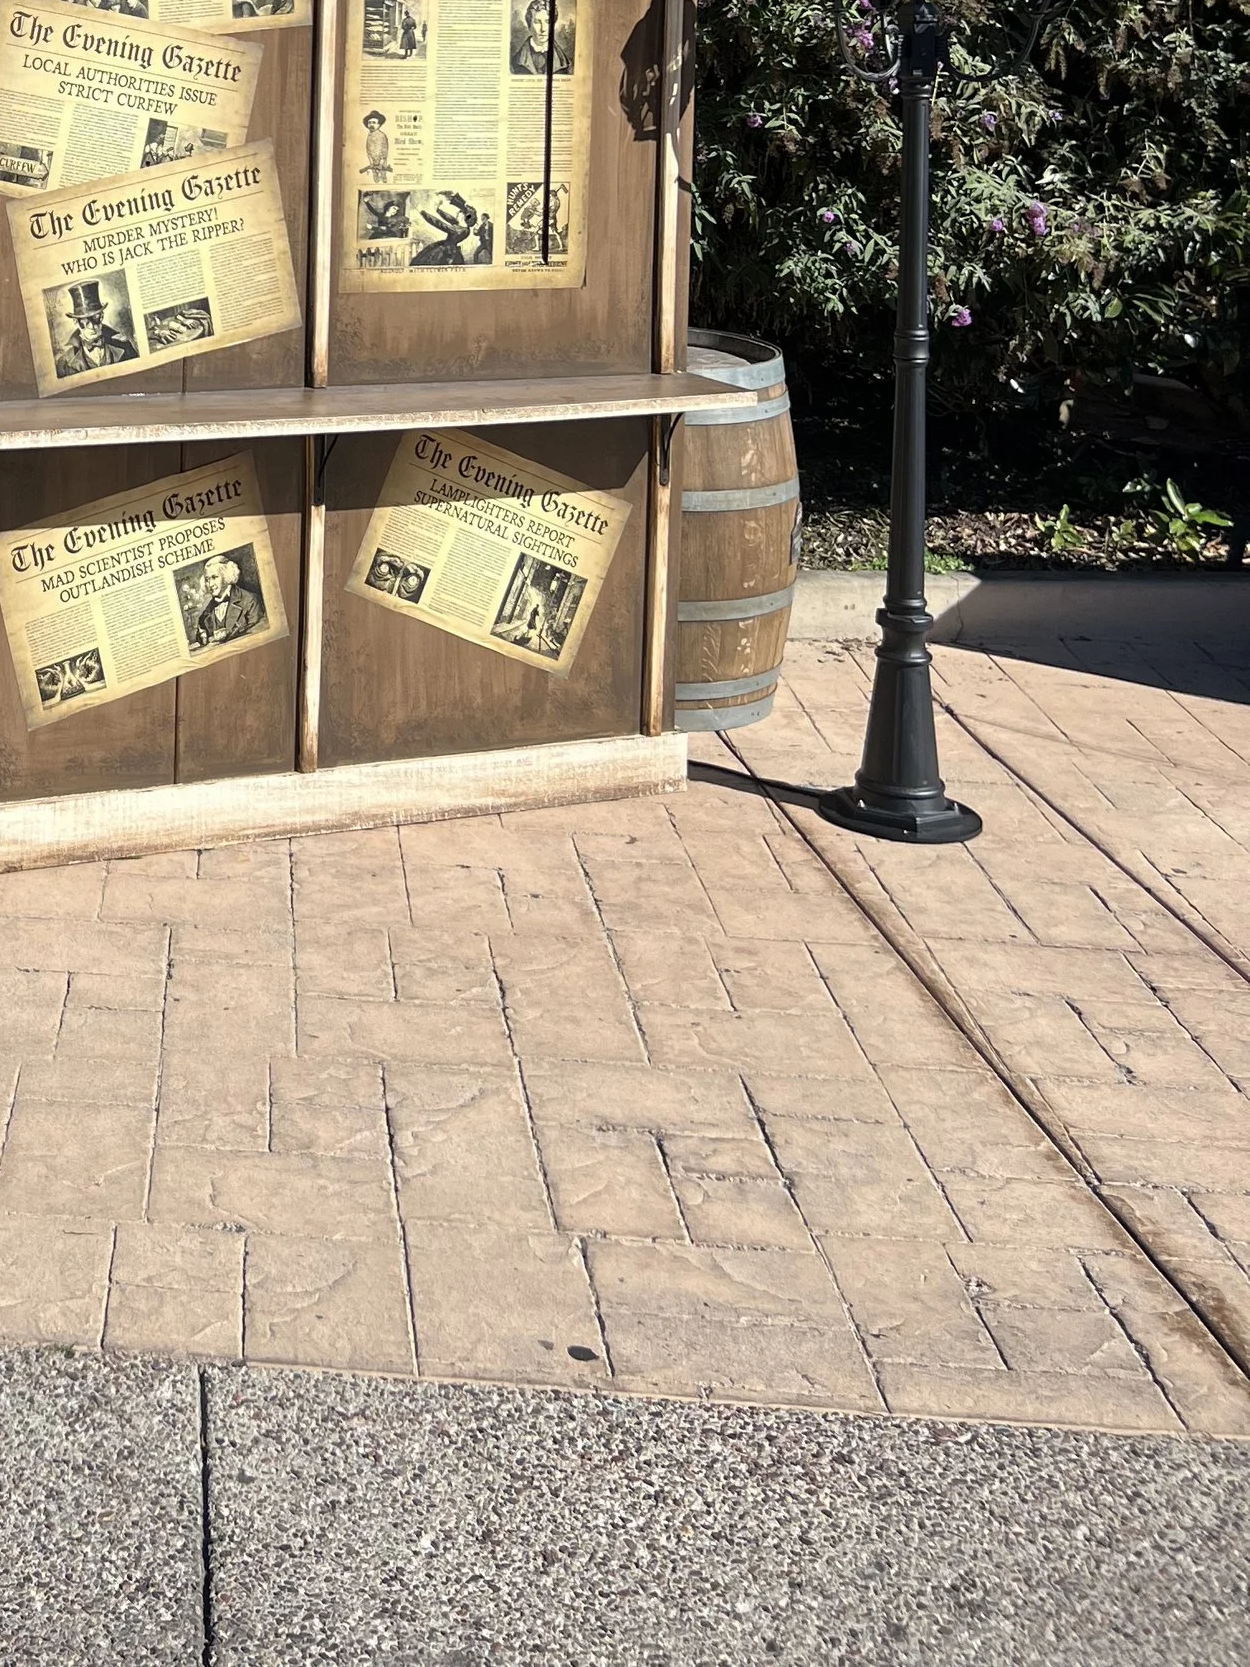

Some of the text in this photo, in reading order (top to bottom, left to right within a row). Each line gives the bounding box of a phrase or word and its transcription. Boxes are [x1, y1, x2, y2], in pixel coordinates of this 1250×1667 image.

[10, 10, 242, 83] The Evening Gazette
[22, 54, 217, 107] LOCAL AUTHORITIES ISSUE
[58, 81, 178, 116] STRICT CURFEW
[0, 157, 37, 174] CURFEW
[30, 165, 261, 239] The Evening Gazette
[83, 207, 219, 254] MURDER MYSTERY!
[508, 185, 536, 216] REMEDY
[61, 218, 245, 276] WHO IS JACK THE RIPPER?
[414, 434, 609, 536] The Evening Gazette
[429, 478, 576, 549] LAMPLIGHTERS REPORT
[11, 479, 243, 573] The Evening Gazette
[41, 517, 226, 593] MAD SCIENTIST PROPOSES
[413, 490, 509, 541] SUPERNATURAL
[511, 531, 580, 569] SIGHTINGS
[59, 538, 216, 604] OUTLANDISH SCHEME
